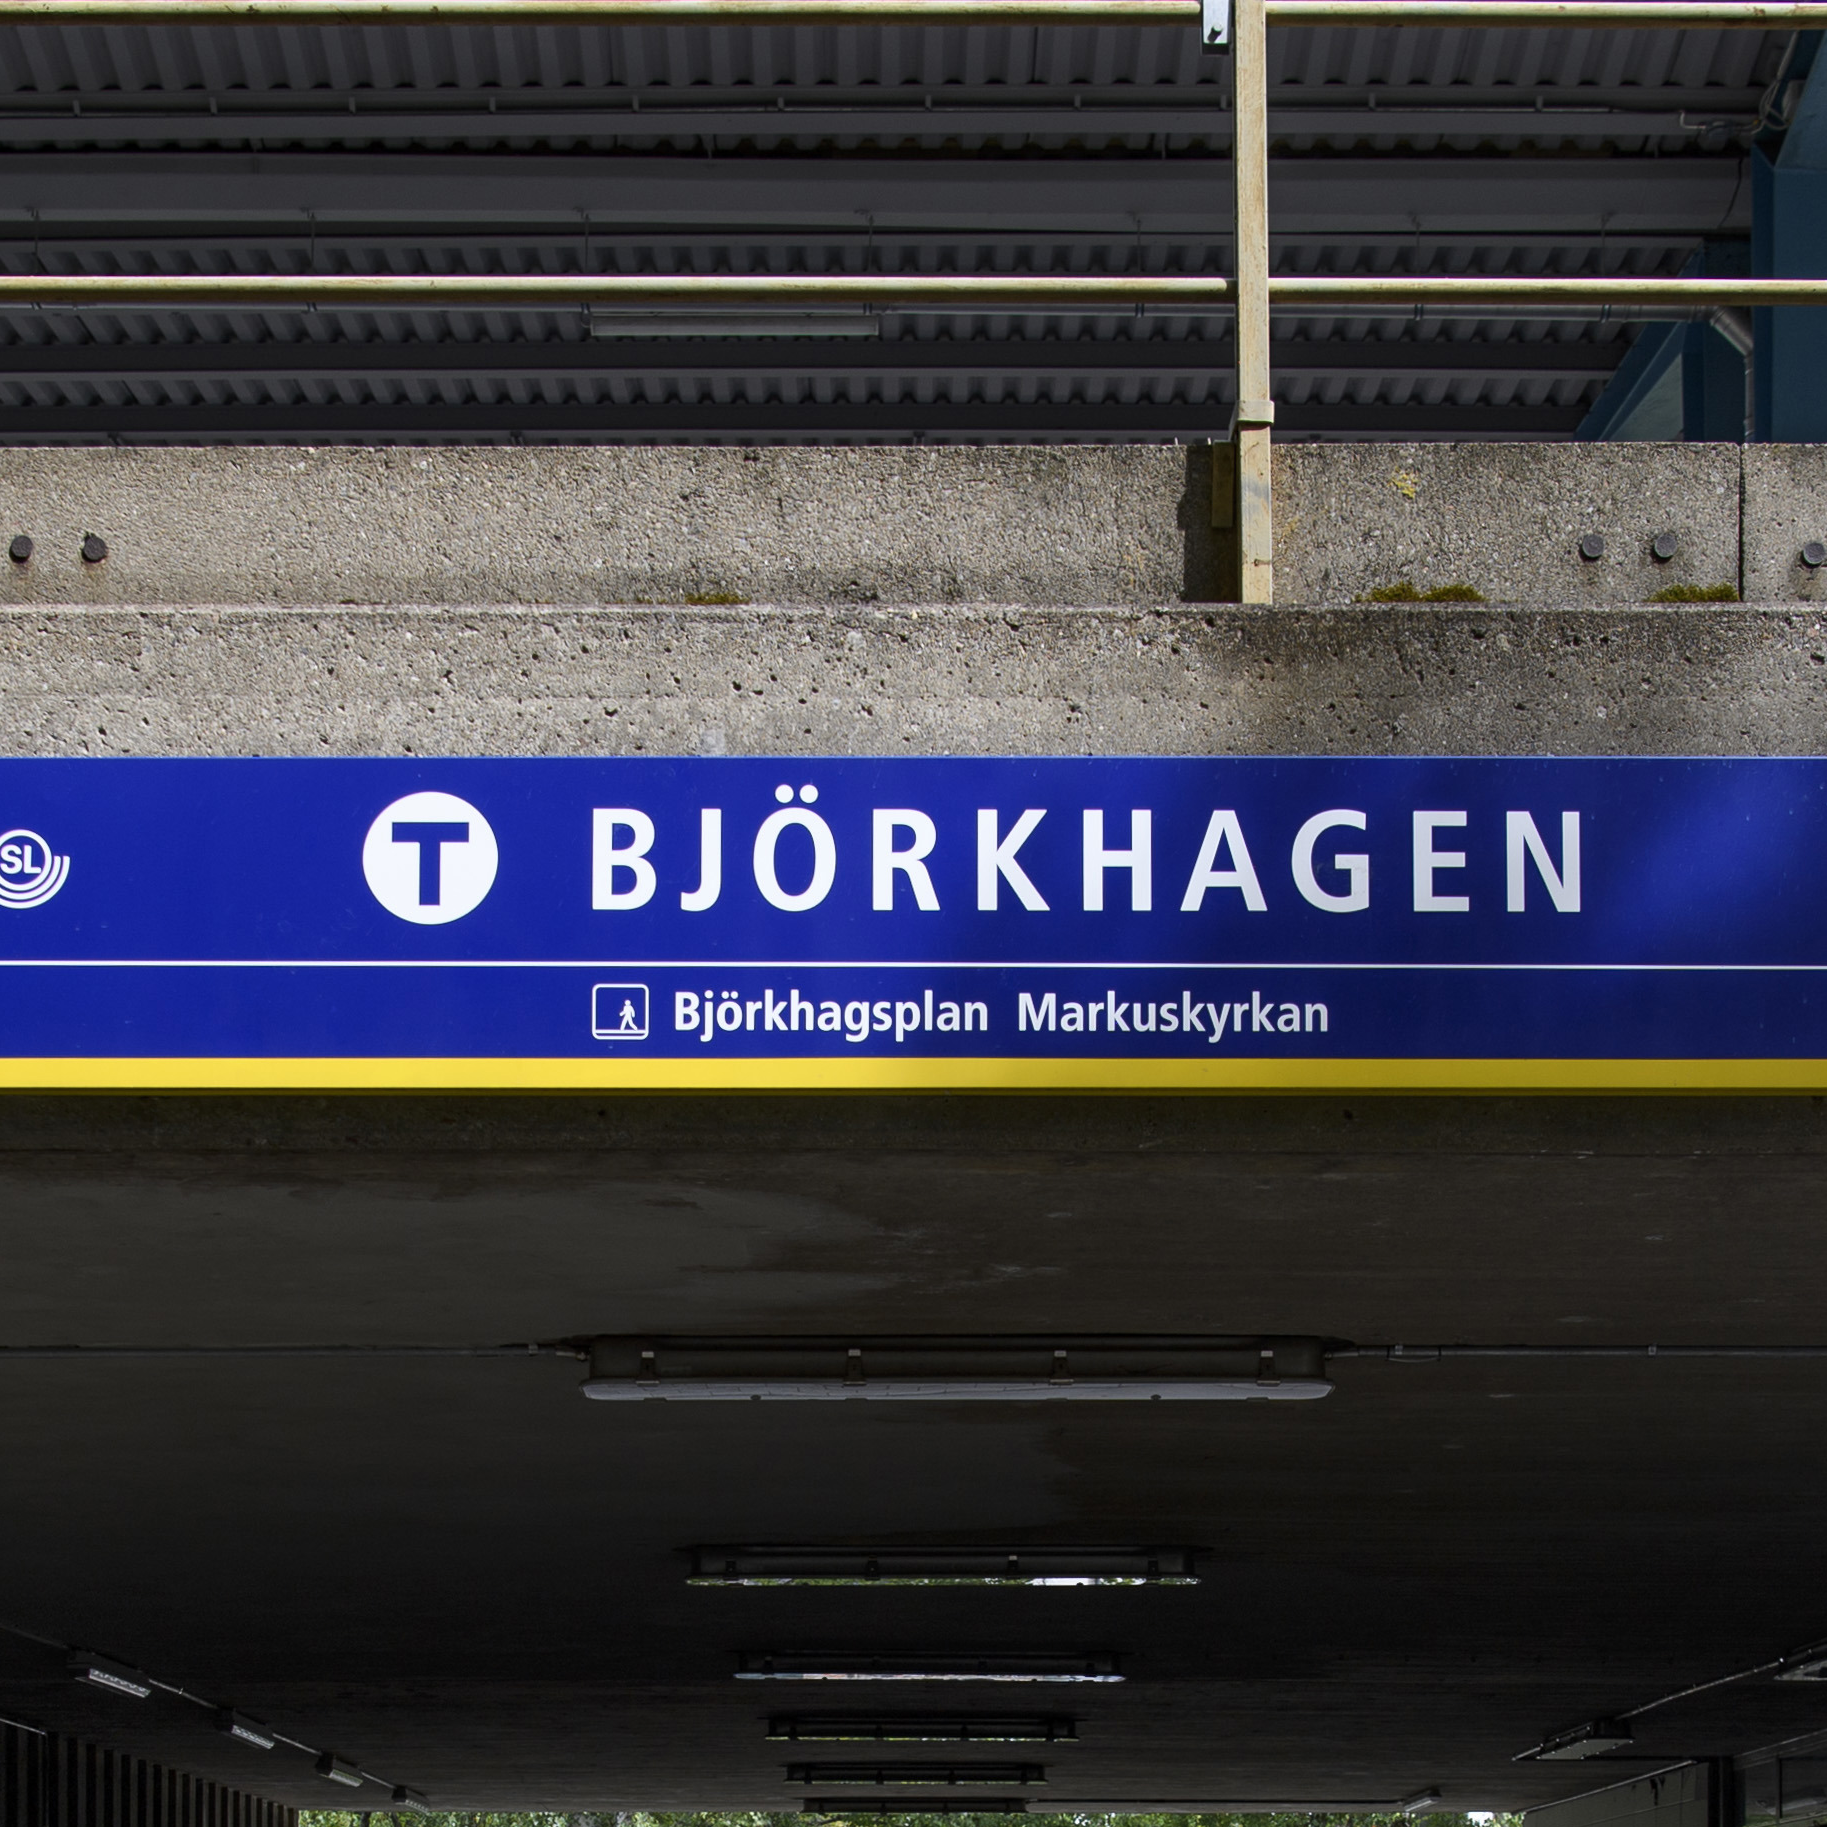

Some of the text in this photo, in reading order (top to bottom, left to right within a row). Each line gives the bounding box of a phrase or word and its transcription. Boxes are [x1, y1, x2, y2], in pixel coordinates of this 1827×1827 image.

[0, 844, 42, 875] SL
[592, 784, 1579, 912] BJÖRKHAGEN
[675, 989, 1327, 1043] Björkhagsplan Markuskyrkan
